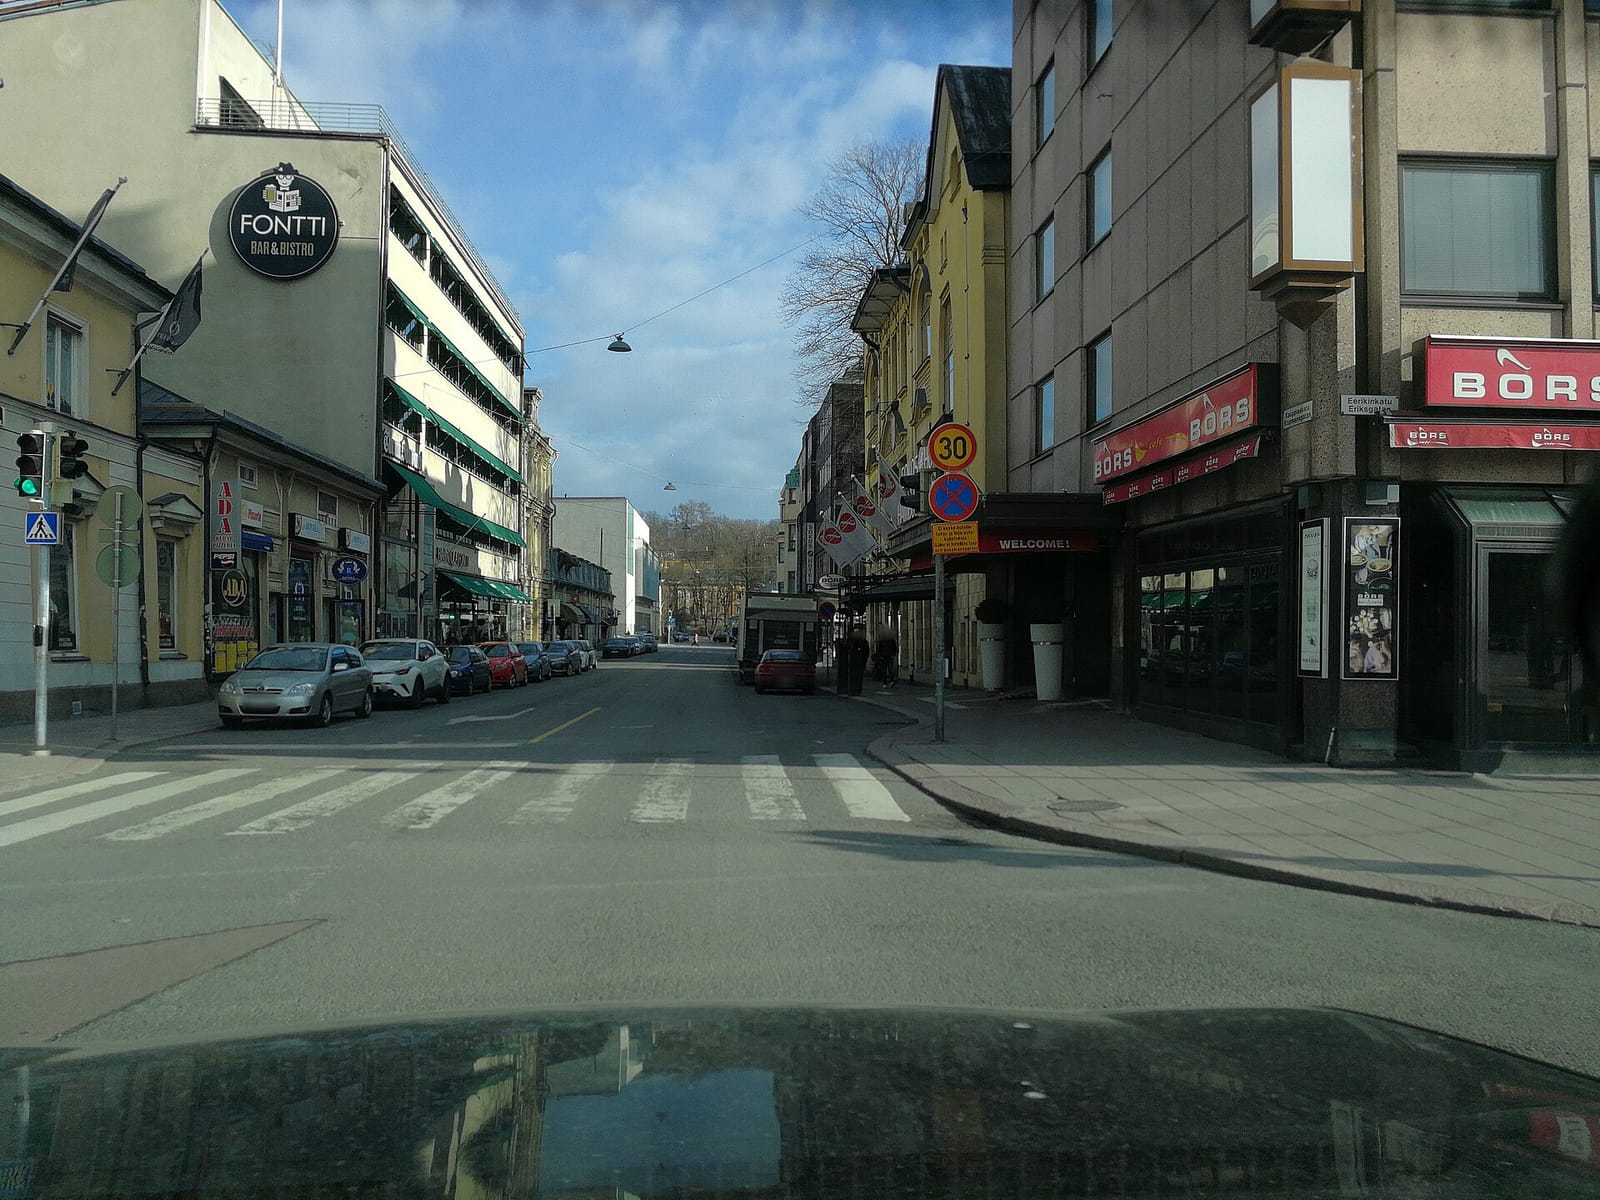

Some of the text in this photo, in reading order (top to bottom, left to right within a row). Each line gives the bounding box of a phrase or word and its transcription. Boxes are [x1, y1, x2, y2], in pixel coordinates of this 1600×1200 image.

[240, 214, 326, 236] FONTTI
[1347, 397, 1393, 405] Eerikinkatu
[939, 436, 967, 460] 30
[217, 481, 232, 534] ADA
[999, 539, 1070, 549] WELCOME!
